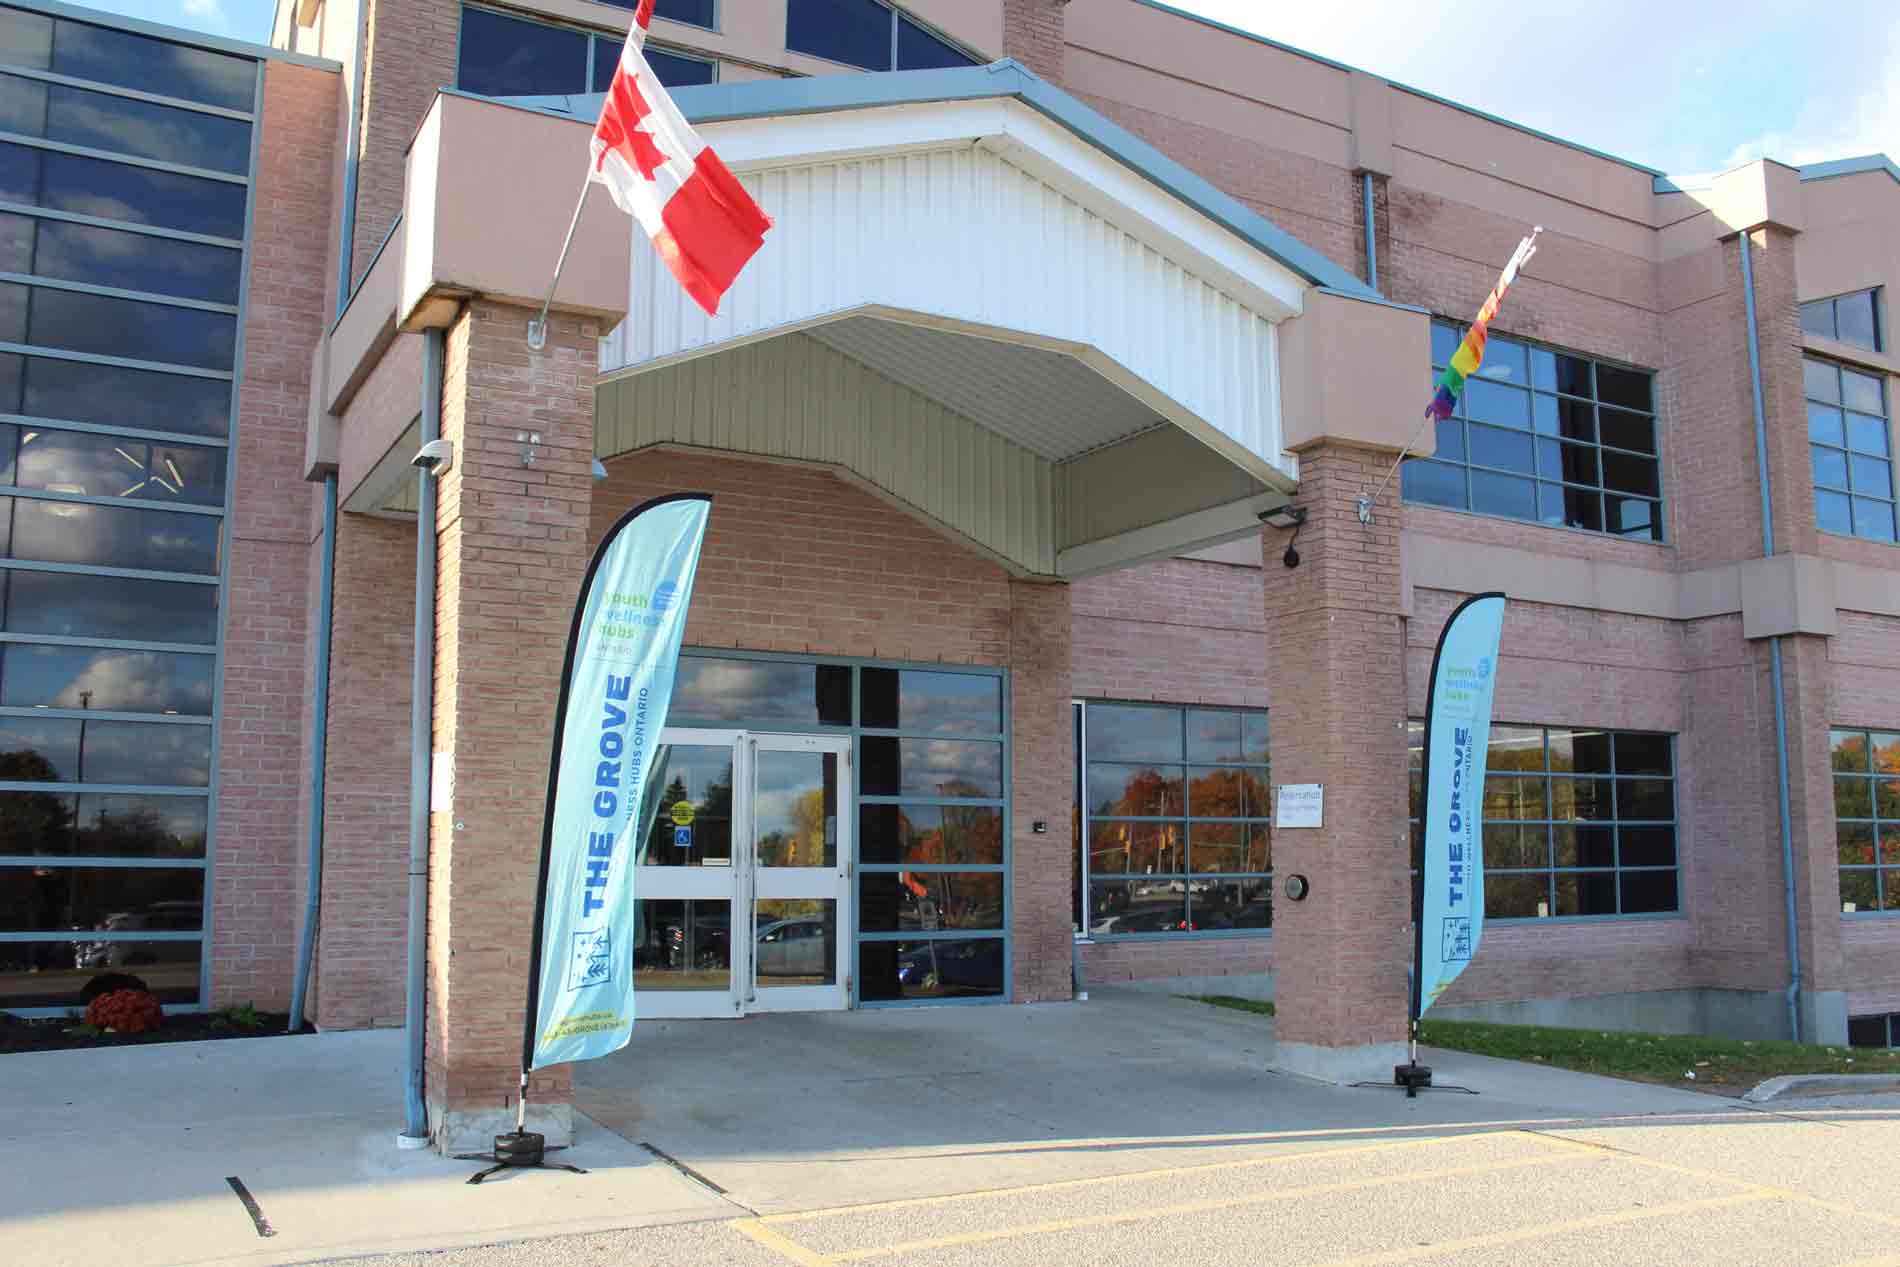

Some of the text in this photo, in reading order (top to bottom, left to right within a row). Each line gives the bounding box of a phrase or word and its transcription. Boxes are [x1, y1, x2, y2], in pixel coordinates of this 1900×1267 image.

[593, 674, 632, 819] GROVE
[634, 687, 649, 746] ONTARIO
[630, 751, 643, 784] HUBS
[1449, 727, 1469, 832] GROVE
[583, 831, 614, 918] THE
[1449, 843, 1463, 907] THE
